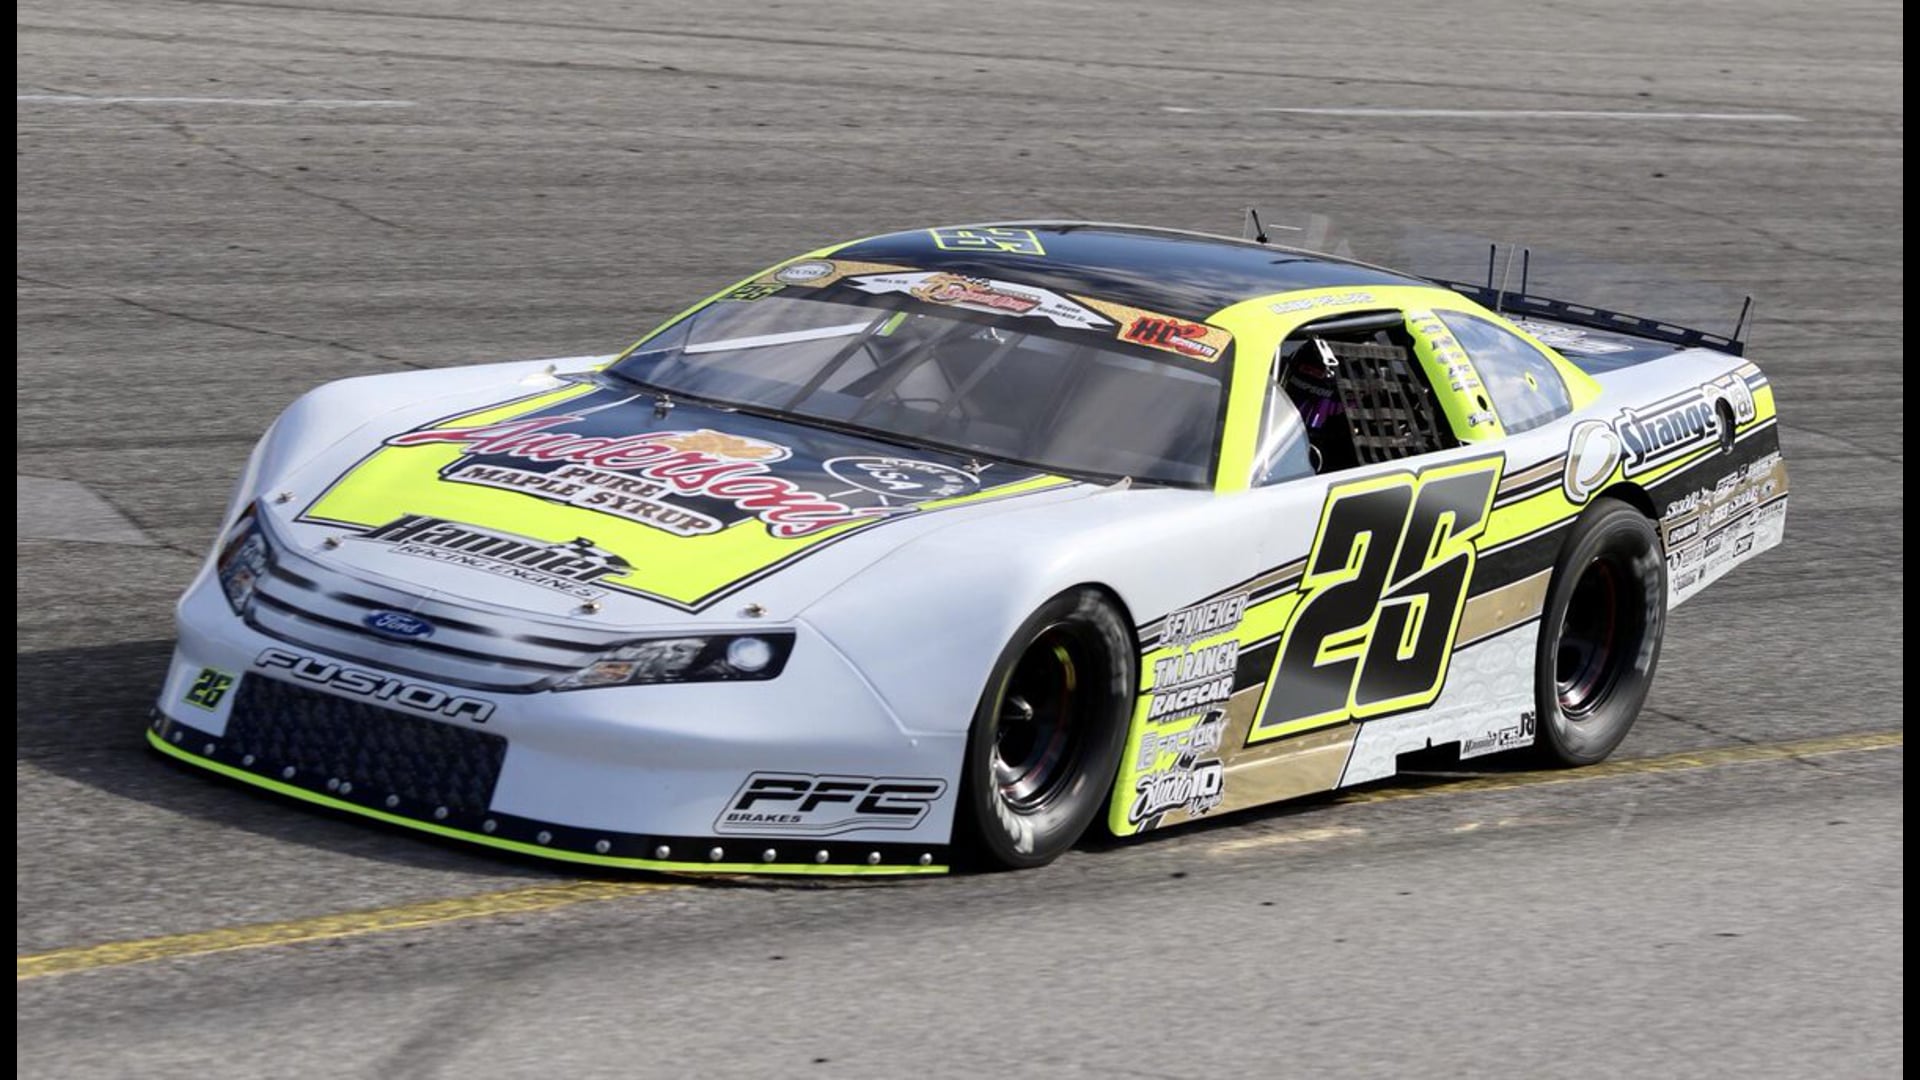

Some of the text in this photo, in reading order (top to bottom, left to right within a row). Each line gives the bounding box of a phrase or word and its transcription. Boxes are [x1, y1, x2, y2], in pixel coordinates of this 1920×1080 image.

[1620, 399, 1716, 470] Strange
[461, 466, 713, 531] MAPLE SYRUP
[557, 466, 663, 498] PURE
[855, 463, 924, 490] USA
[404, 545, 593, 598] RACING ENGINES
[1159, 594, 1248, 645] SENNEKER
[1246, 453, 1505, 745] 26
[375, 613, 422, 633] Ford
[1181, 640, 1240, 681] RANCH
[184, 667, 233, 712] 26
[253, 648, 496, 723] FUSION
[1149, 676, 1233, 719] RACECAR
[725, 813, 802, 823] BRAKES
[733, 779, 942, 815] PFC
